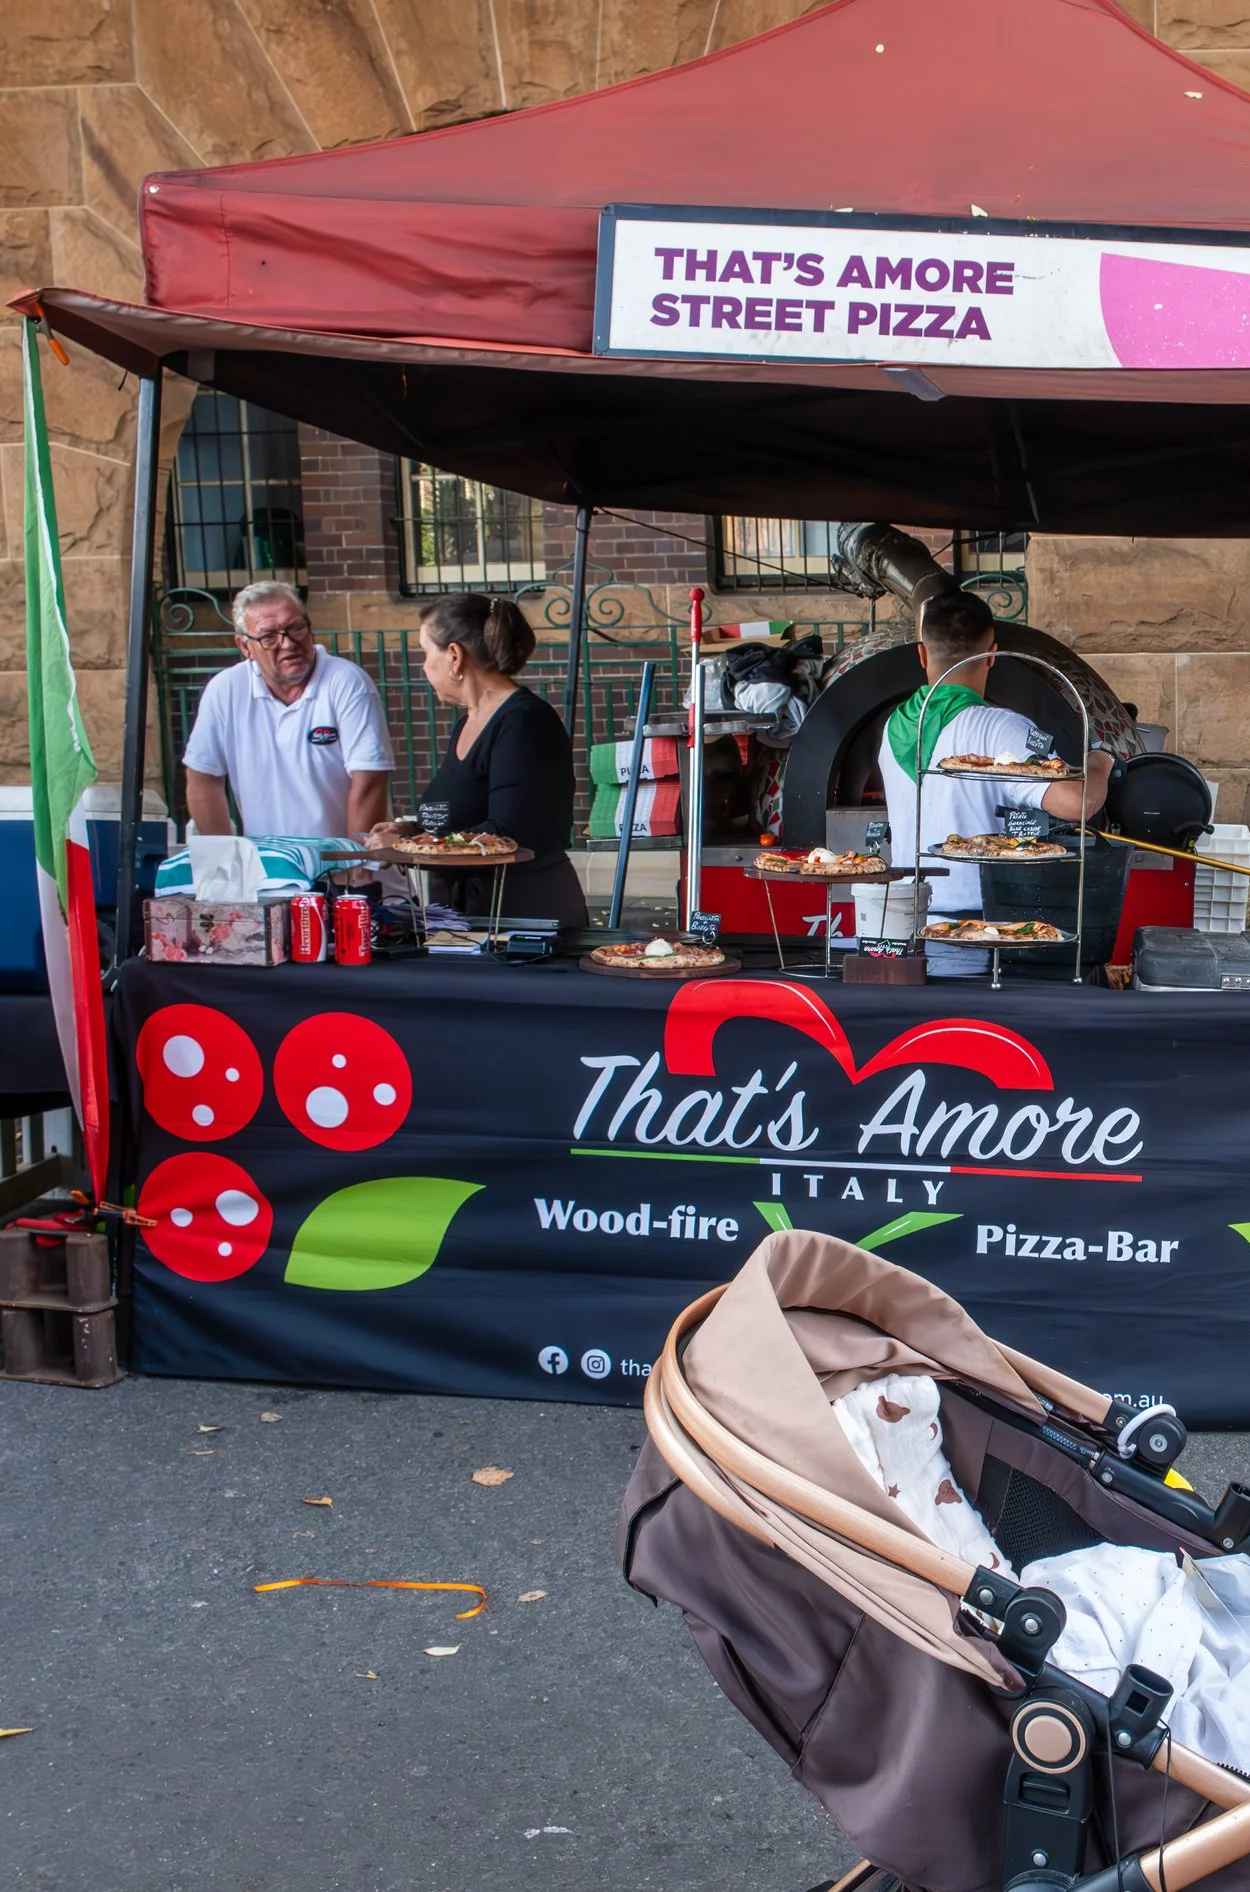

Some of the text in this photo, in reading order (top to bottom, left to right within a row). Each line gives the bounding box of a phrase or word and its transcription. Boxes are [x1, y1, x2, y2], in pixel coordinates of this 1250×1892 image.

[654, 247, 1014, 296] THAT'S AMORE
[650, 293, 992, 341] STREET PIZZA
[621, 764, 649, 776] PIA
[619, 823, 647, 832] PZA
[573, 1050, 1144, 1166] That's Amore
[772, 1172, 945, 1205] ITALY
[533, 1197, 1179, 1264] Wood-fire Pizza-Bar
